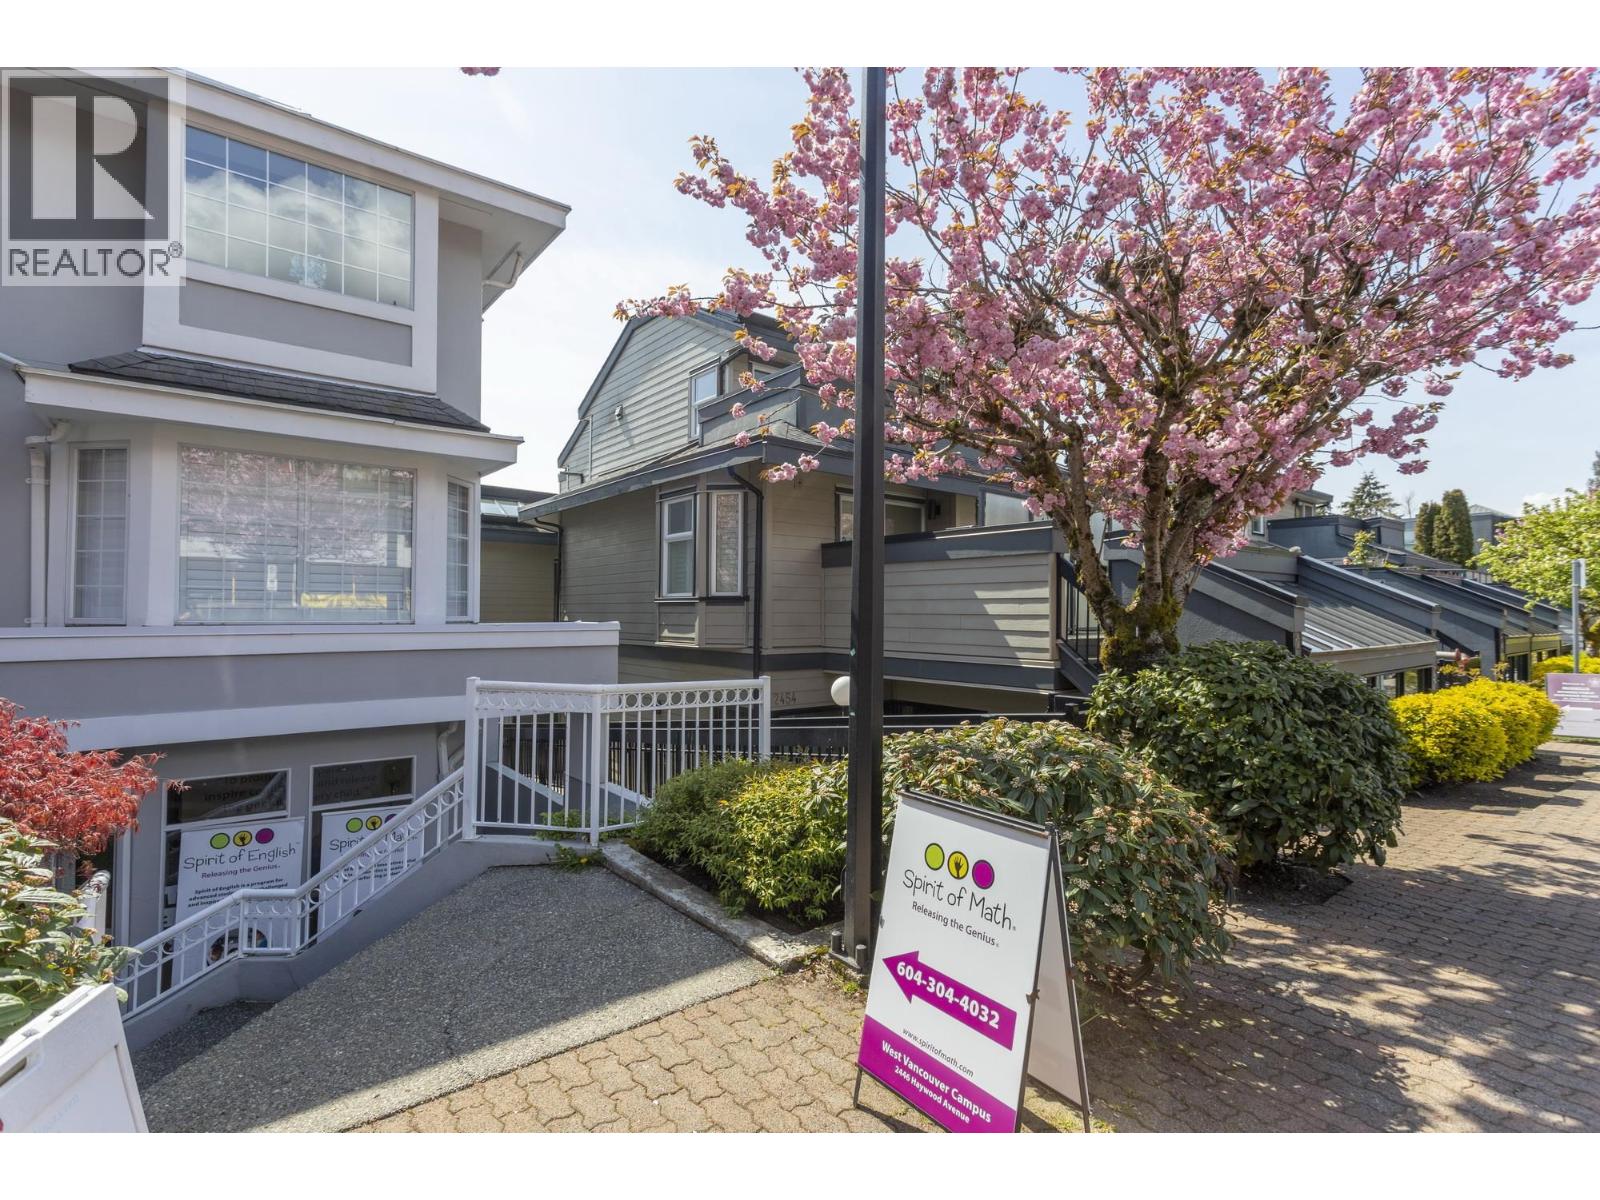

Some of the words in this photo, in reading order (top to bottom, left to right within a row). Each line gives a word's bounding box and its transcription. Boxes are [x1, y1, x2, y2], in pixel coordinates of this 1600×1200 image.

[773, 691, 797, 705] 2454
[184, 853, 225, 872] Spirit
[229, 848, 246, 864] of
[248, 842, 296, 863] English
[201, 869, 238, 880] Releasing
[240, 867, 252, 875] the
[253, 863, 278, 873] Genius
[188, 893, 217, 901] advanced
[194, 887, 211, 895] Spirit
[219, 883, 240, 892] English
[251, 878, 275, 888] program
[902, 869, 945, 901] Spirit
[947, 886, 968, 906] of
[912, 901, 949, 927] Releasing
[950, 917, 964, 933] the
[896, 961, 1001, 1030] 604-304-4032
[902, 1027, 975, 1078] www.spiritofmath.com
[882, 1039, 902, 1062] West
[903, 1053, 950, 1094] Vancouver
[951, 1087, 993, 1124] Campus
[894, 1065, 911, 1081] 2446
[910, 1073, 942, 1104] Haywood
[943, 1099, 971, 1124] Avenue
